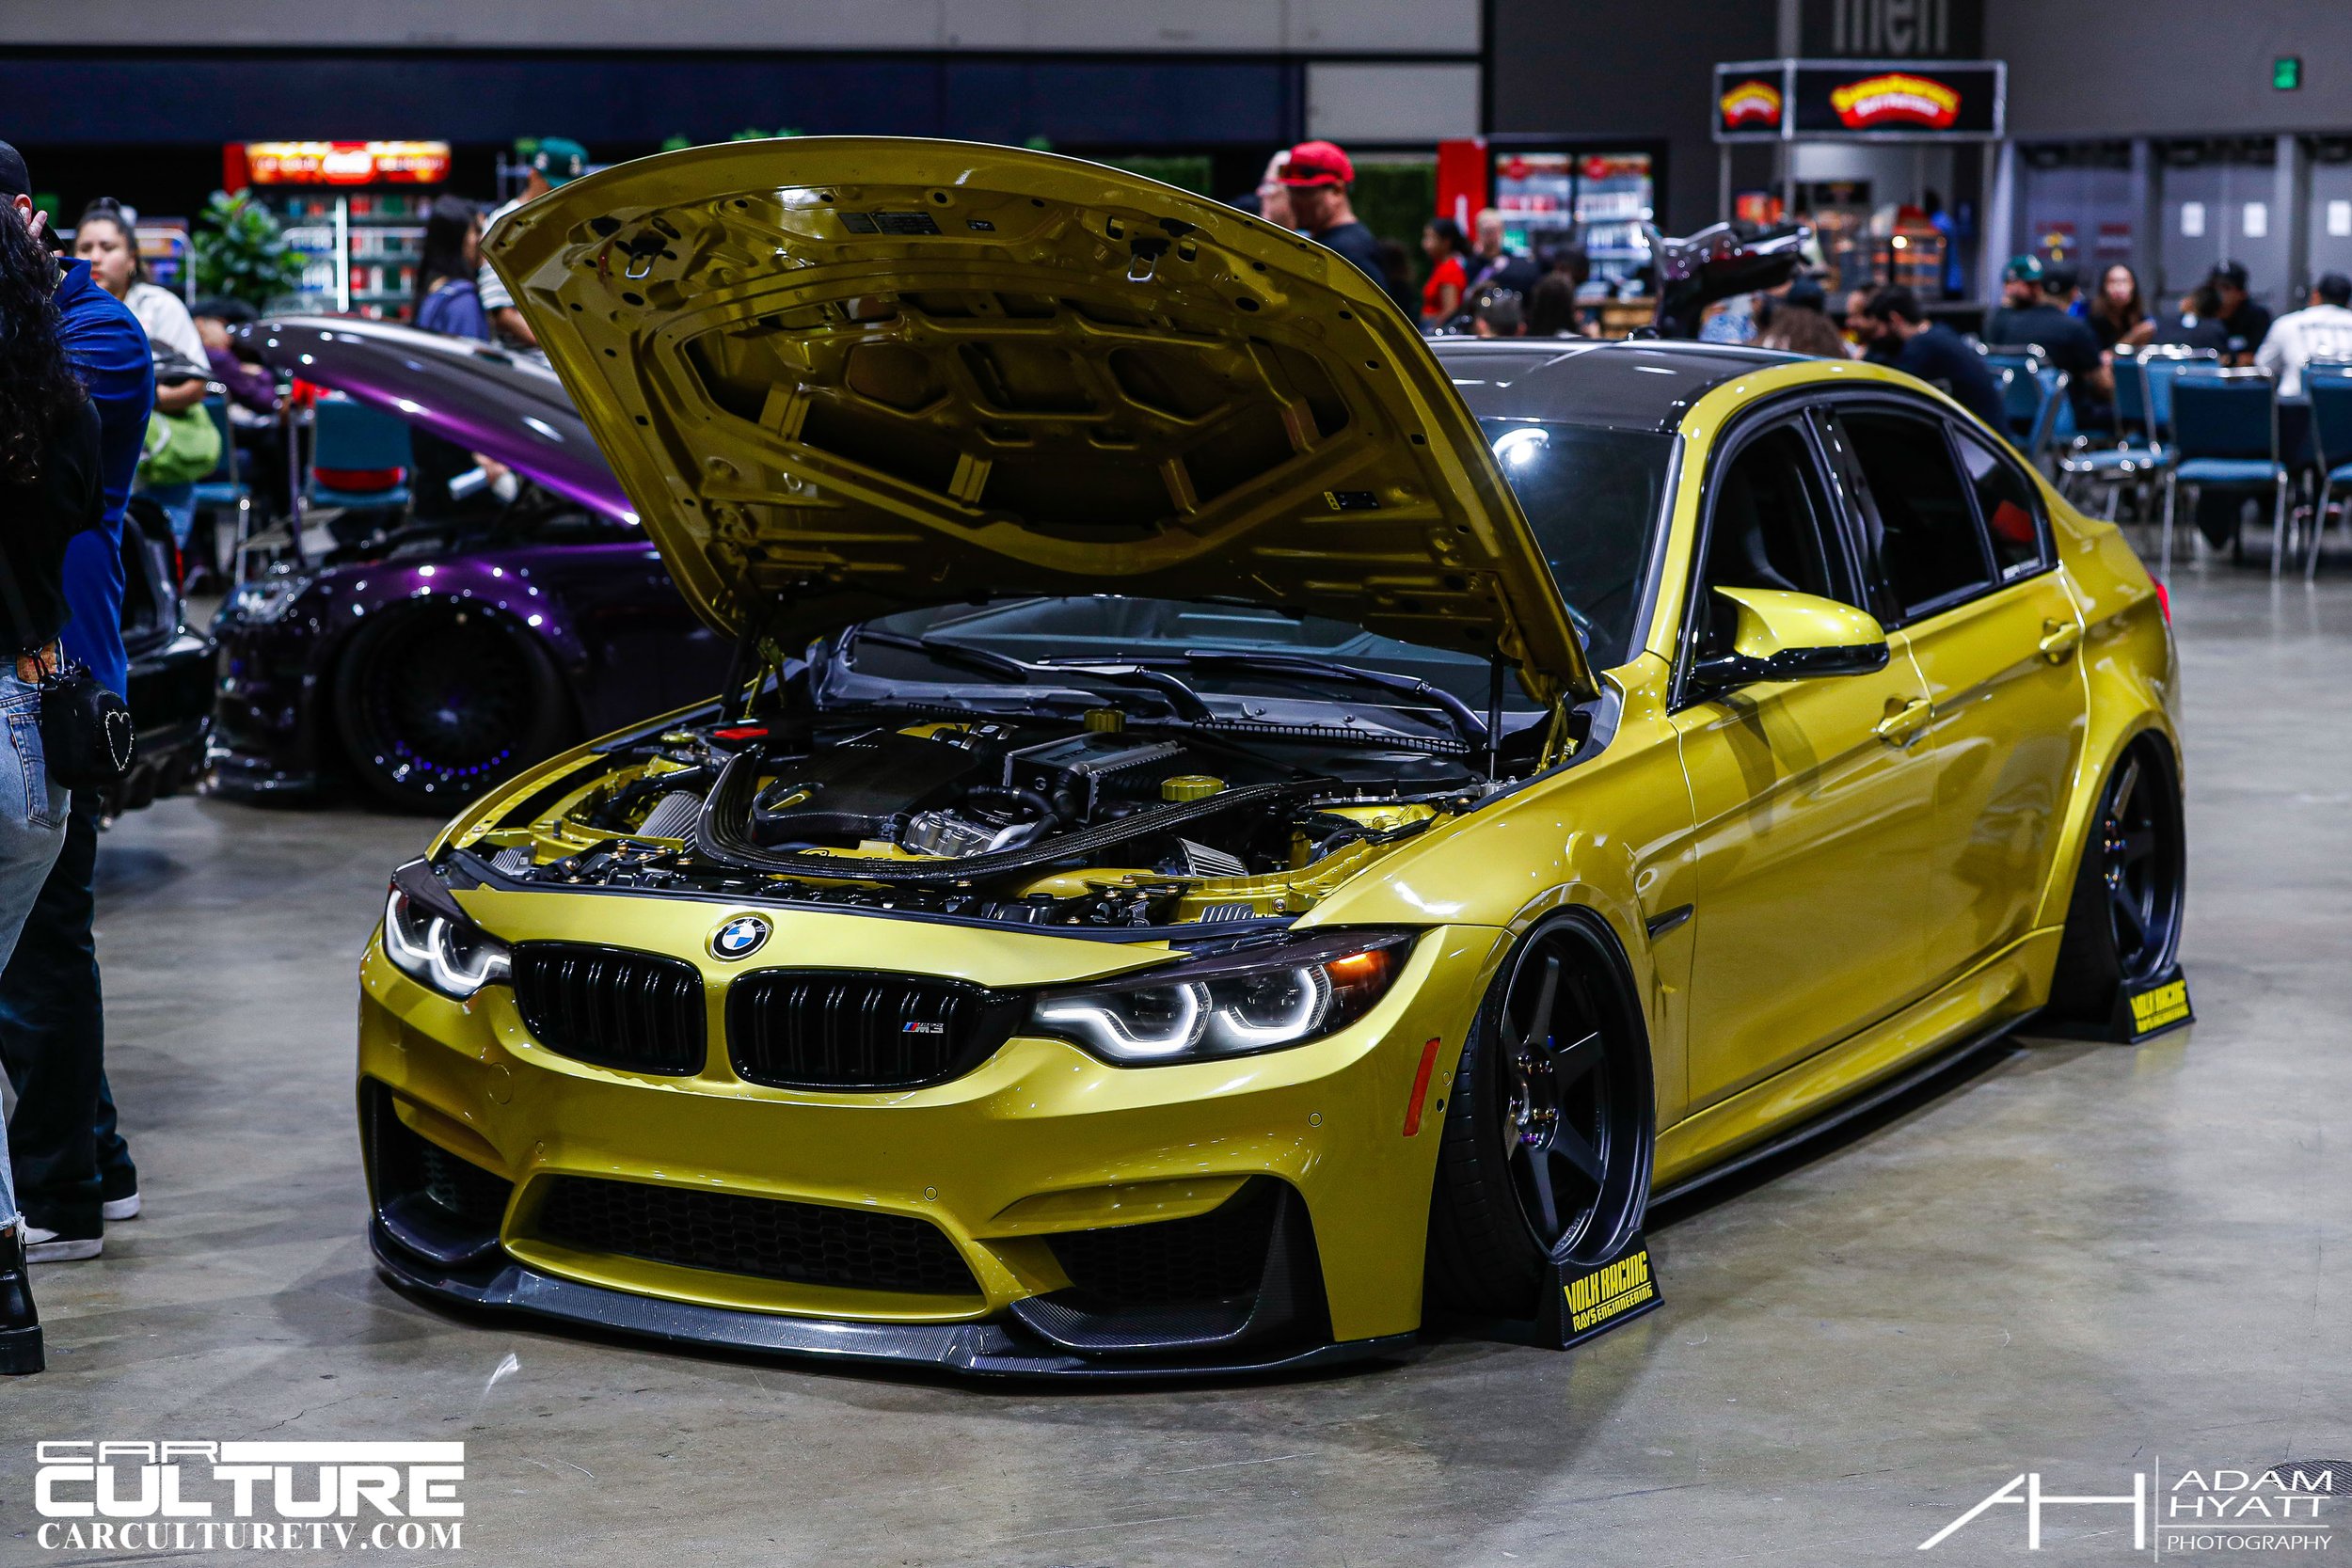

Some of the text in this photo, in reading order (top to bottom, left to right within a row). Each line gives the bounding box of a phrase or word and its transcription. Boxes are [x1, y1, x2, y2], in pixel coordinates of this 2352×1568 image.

[914, 1022, 944, 1034] M3
[1564, 1250, 1648, 1315] VOLK RACING
[1572, 1307, 1597, 1332] RAYS
